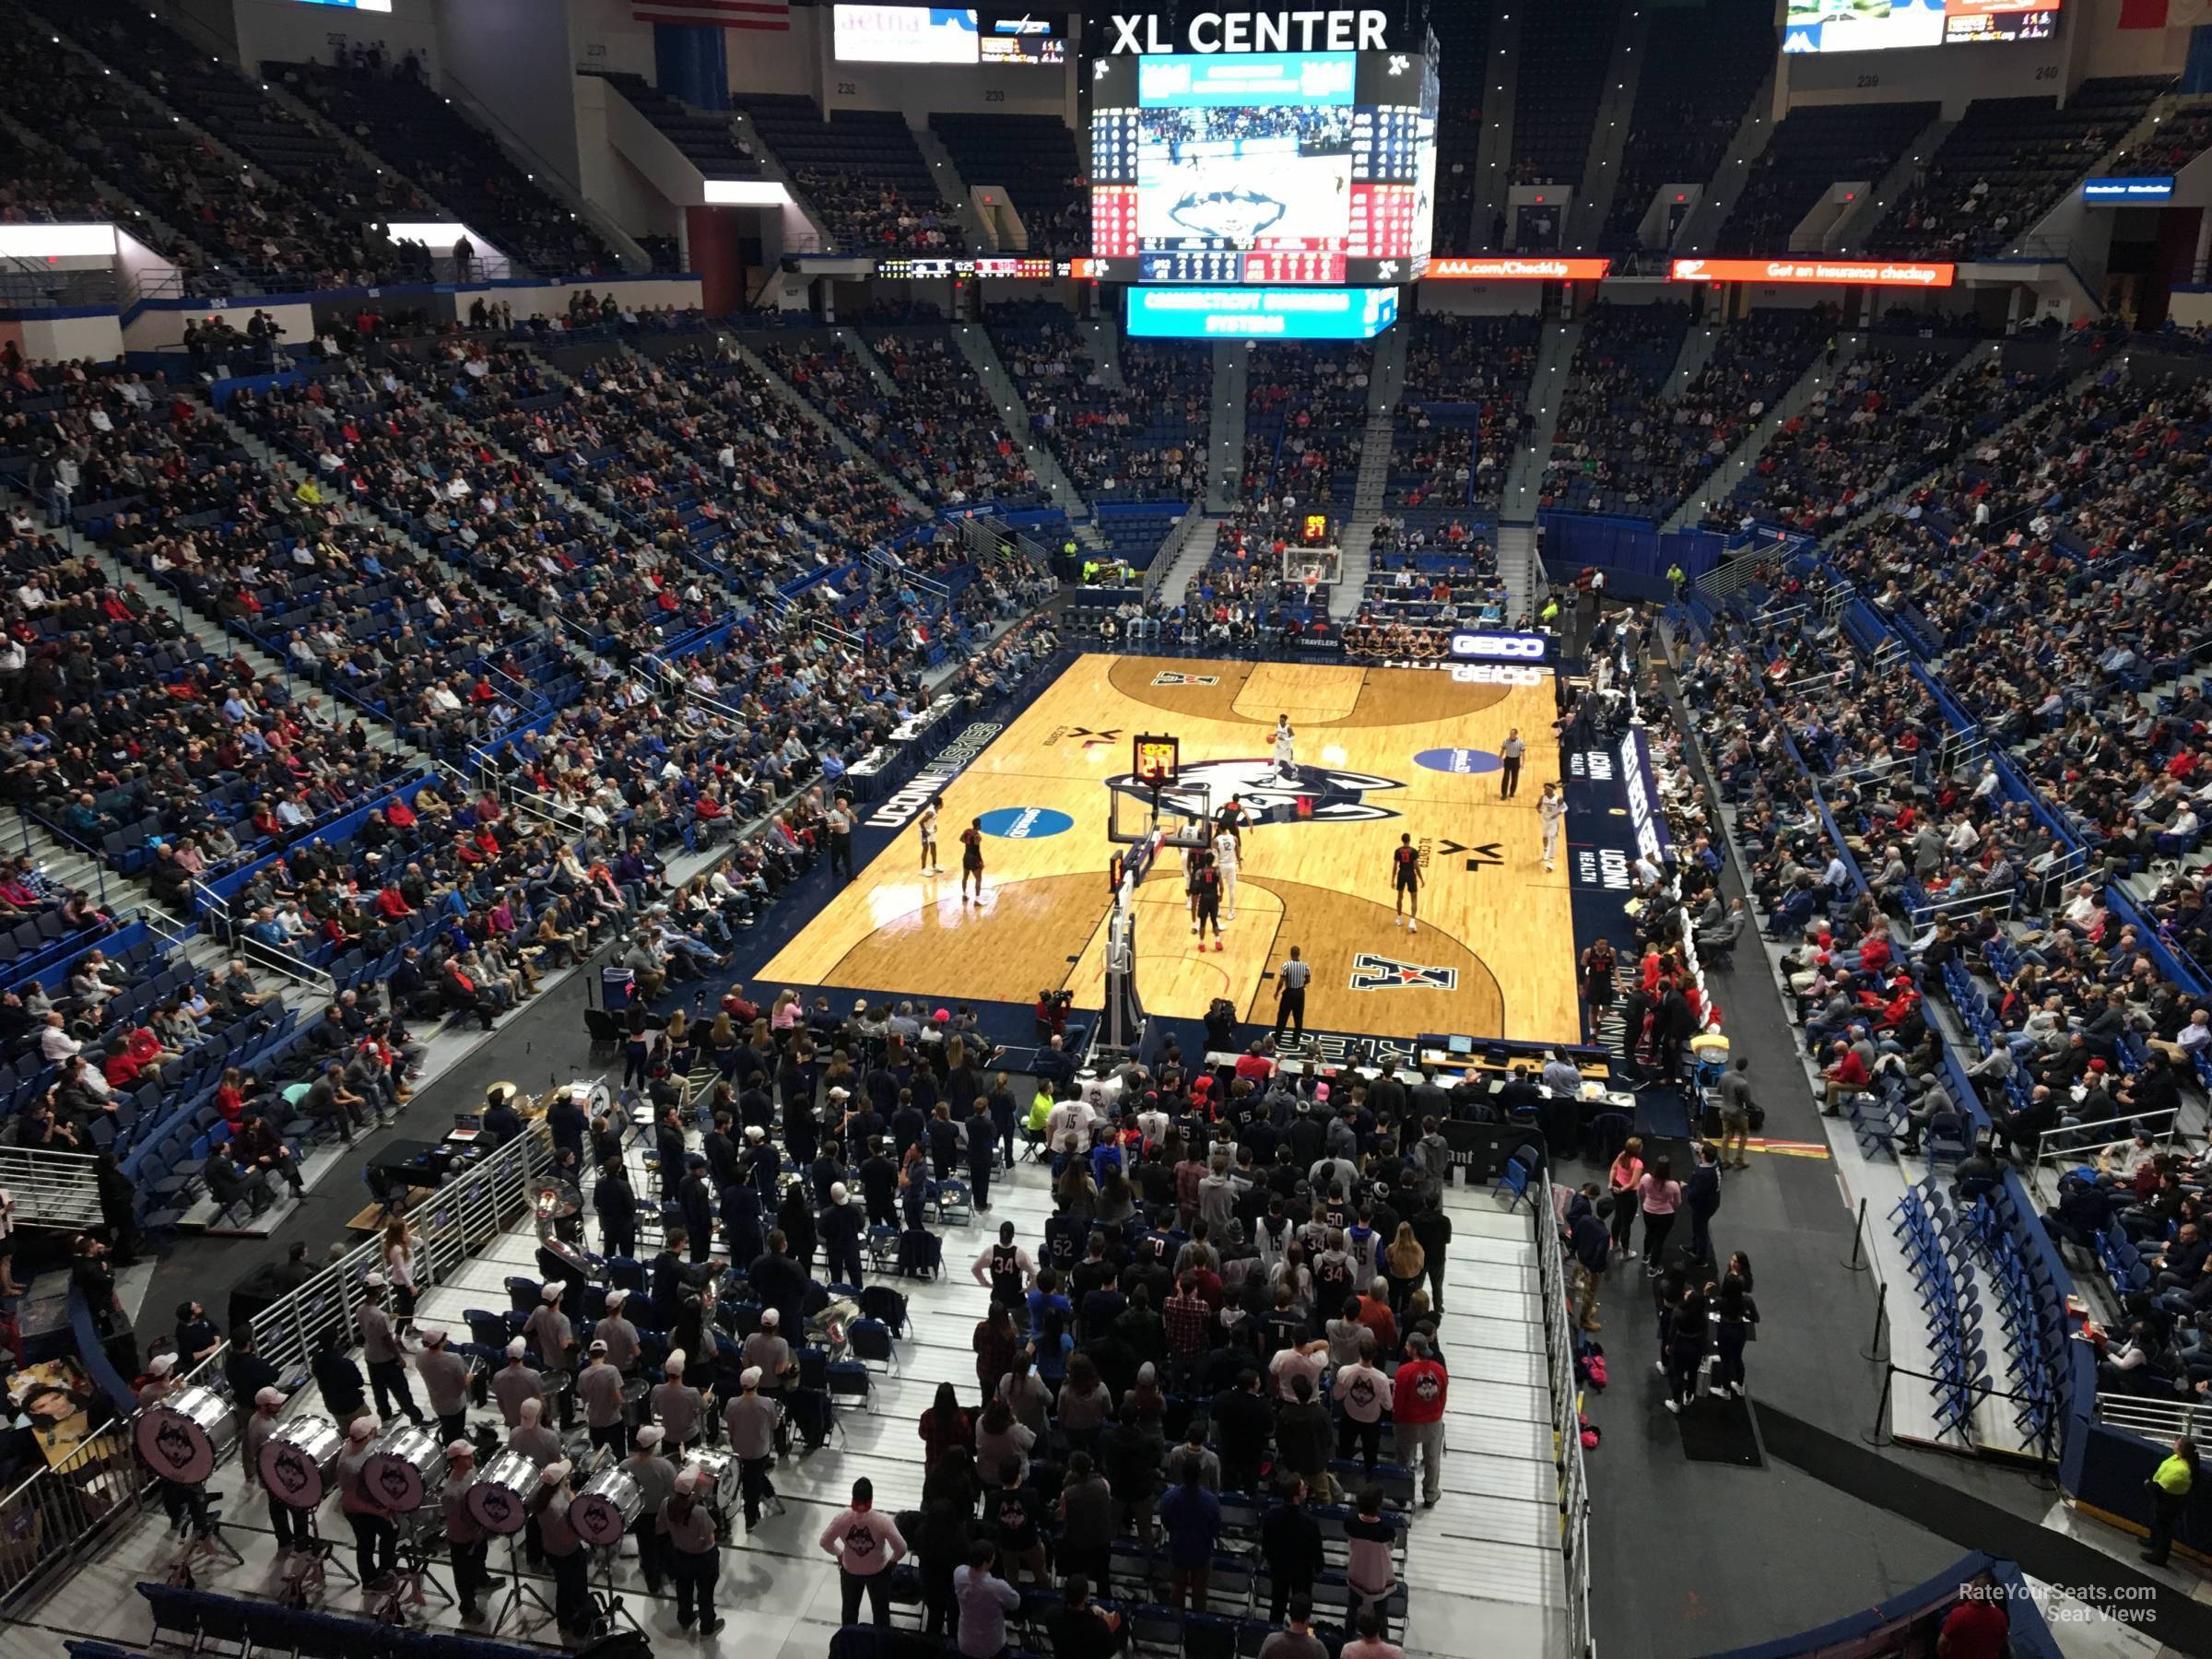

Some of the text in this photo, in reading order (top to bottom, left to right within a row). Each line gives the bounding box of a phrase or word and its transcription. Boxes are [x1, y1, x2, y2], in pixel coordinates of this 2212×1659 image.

[841, 11, 920, 31] aetna
[1111, 9, 1388, 53] XL CENTER
[1388, 55, 1410, 76] XL
[2035, 66, 2058, 79] 240
[838, 83, 855, 94] 232
[1857, 76, 1878, 88] 239
[985, 90, 1005, 101] 233
[1437, 262, 1568, 276] AAA.com/CheckUp
[1767, 264, 1936, 284] Get an insurance checkup
[1307, 524, 1324, 536] 27
[1300, 638, 1338, 647] TRAVELERS
[1453, 635, 1545, 657] GEICO
[1571, 752, 1585, 776] HEALTH
[1621, 730, 1639, 782] GEICO
[1143, 756, 1169, 777] 27
[1587, 751, 1613, 780] UCONN
[865, 722, 1003, 828] UCONN HUSKIES
[1628, 771, 1648, 828] GEICO
[1223, 841, 1231, 852] 12
[1438, 839, 1505, 872] XL
[1580, 852, 1597, 883] HEALTH
[1598, 850, 1630, 889] UCONN
[1065, 1113, 1077, 1130] 15
[1239, 1111, 1252, 1124] 15
[1149, 1119, 1156, 1134] 3
[1327, 1213, 1344, 1227] 50
[1053, 1240, 1073, 1257] 52
[1270, 1236, 1283, 1252] 15
[1308, 1239, 1325, 1252] 34
[1353, 1246, 1368, 1265] 15
[994, 1257, 1014, 1274] 34
[1324, 1266, 1344, 1283] 34
